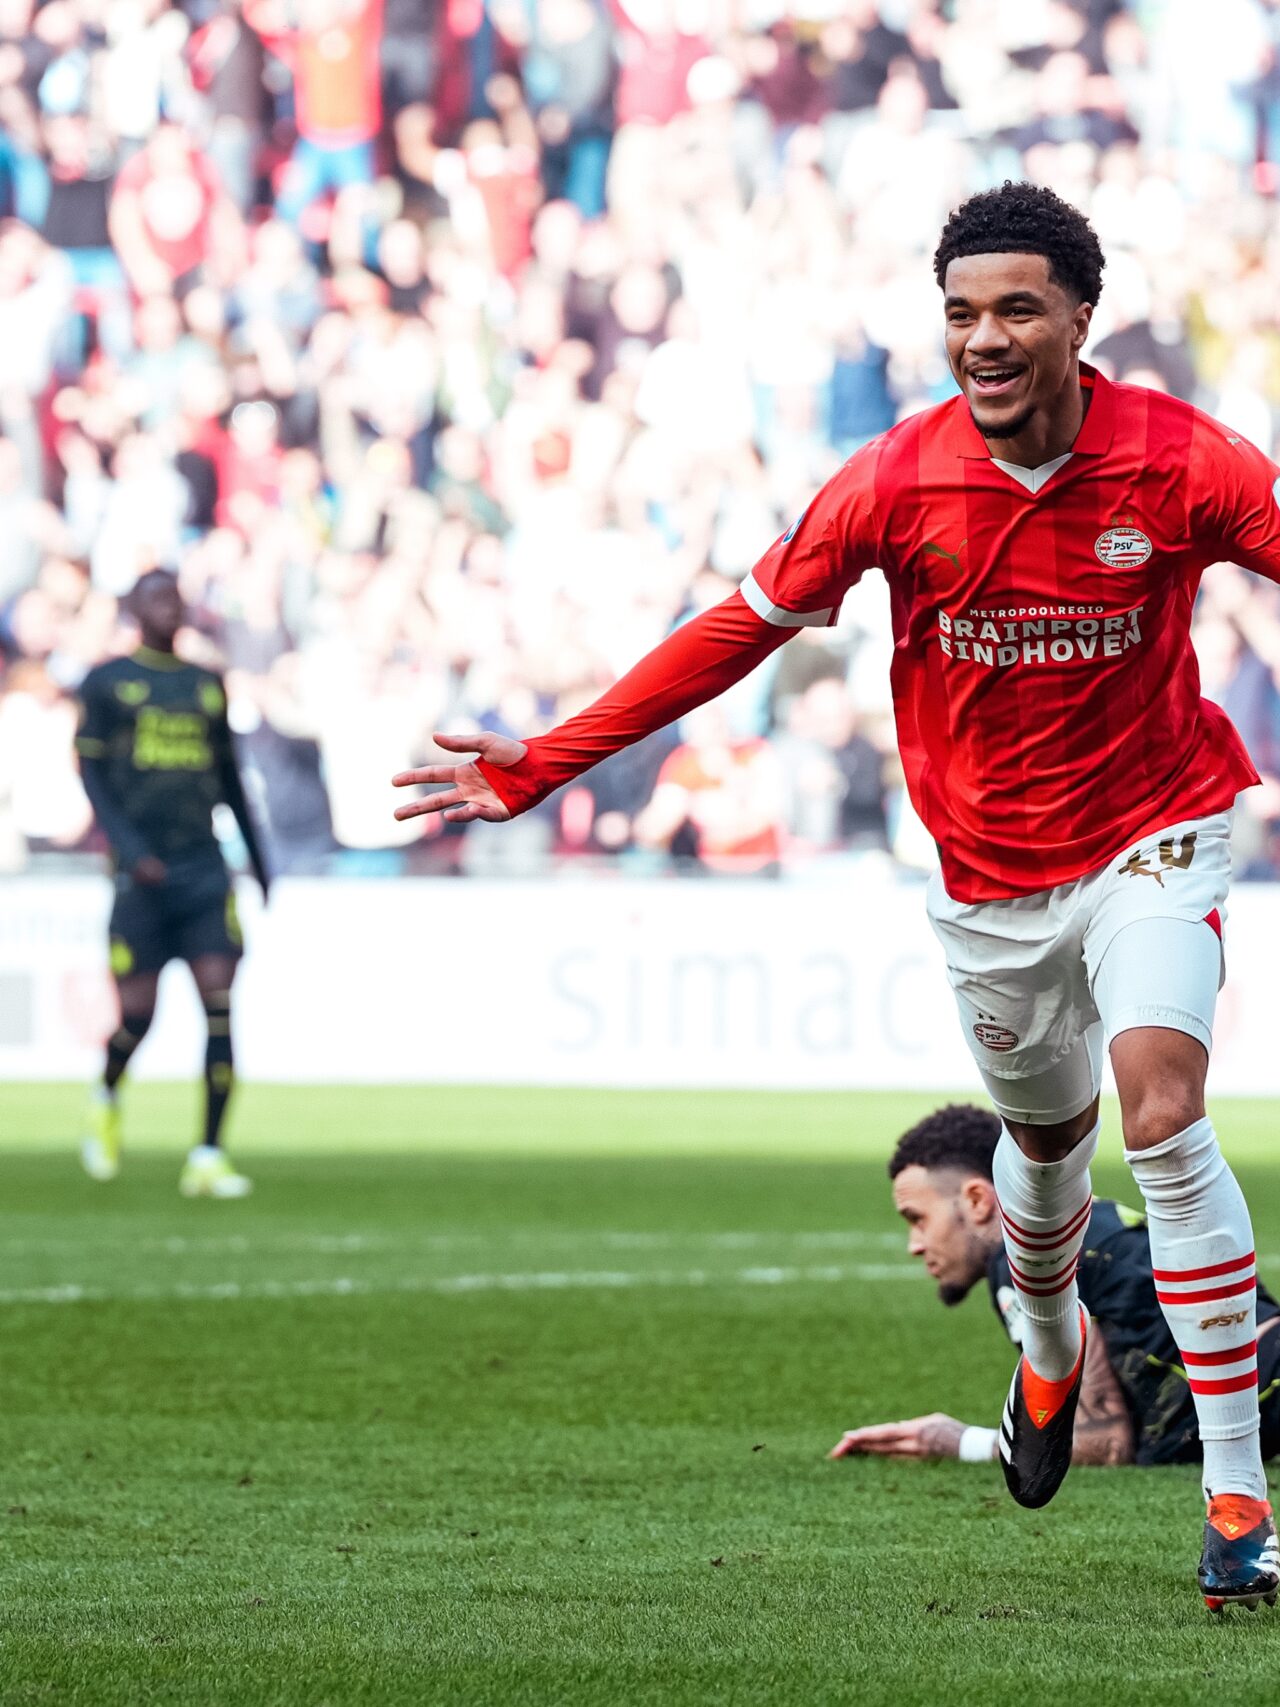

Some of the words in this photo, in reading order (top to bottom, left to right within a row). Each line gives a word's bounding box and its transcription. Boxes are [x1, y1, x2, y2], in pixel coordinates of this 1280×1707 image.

[1113, 541, 1134, 551] PSV
[969, 606, 1104, 618] METROPOOLREGIO
[938, 606, 1144, 643] BRAINPORT
[938, 624, 1142, 667] EINDHOVEN
[547, 910, 934, 1057] simac
[985, 1032, 1002, 1041] PSV
[1200, 1309, 1249, 1331] PSV
